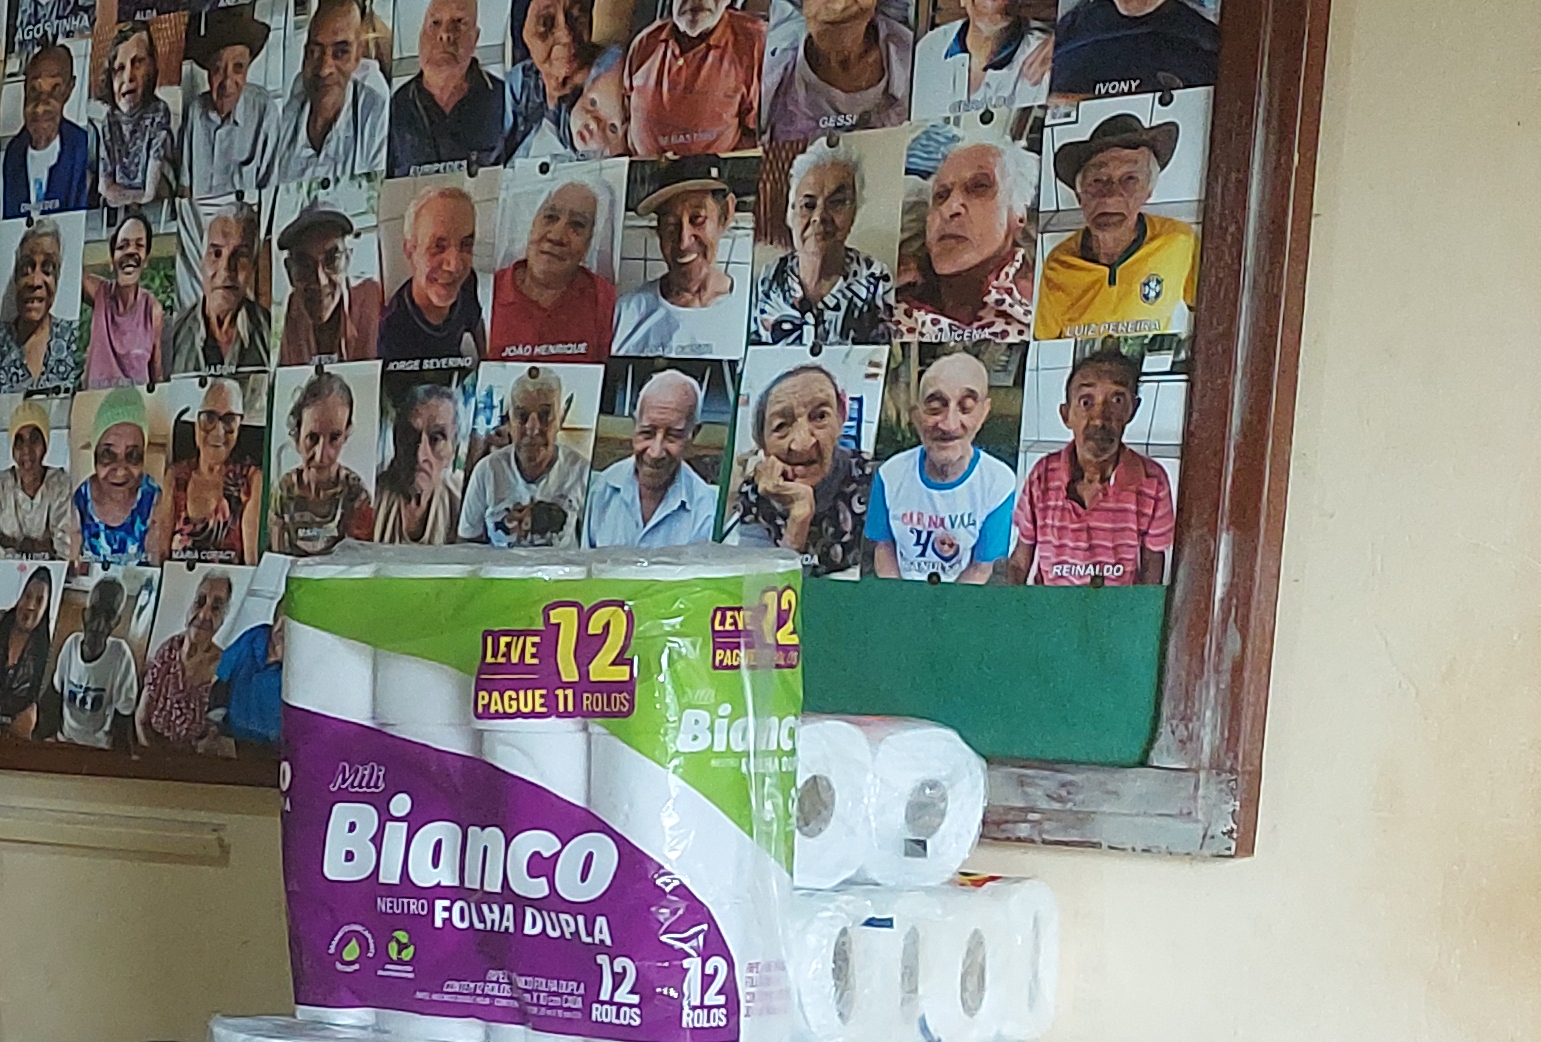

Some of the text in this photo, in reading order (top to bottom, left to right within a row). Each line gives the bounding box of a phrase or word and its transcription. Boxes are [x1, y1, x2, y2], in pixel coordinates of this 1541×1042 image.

[16, 12, 91, 42] AGOSTINHA
[1095, 80, 1140, 96] IVONY
[819, 114, 857, 128] GESSI
[1100, 320, 1160, 334] PEREIRA
[387, 357, 473, 371] JORGE SEVERINO
[502, 343, 587, 357] JOÃO HENRIQUE
[1052, 564, 1123, 578] REINALDO
[762, 588, 799, 645] 12
[486, 635, 539, 665] LEVE
[549, 606, 631, 683] 12
[477, 688, 630, 714] PAGUE 11 ROLOS
[330, 762, 386, 793] Mili
[323, 794, 619, 902] Bianco
[376, 896, 613, 947] NEUTRO FOLHA DUPLA
[596, 954, 641, 1005] 12
[683, 954, 728, 1007] 12
[591, 1004, 642, 1027] ROLOS
[682, 1006, 727, 1029] ROLOS
